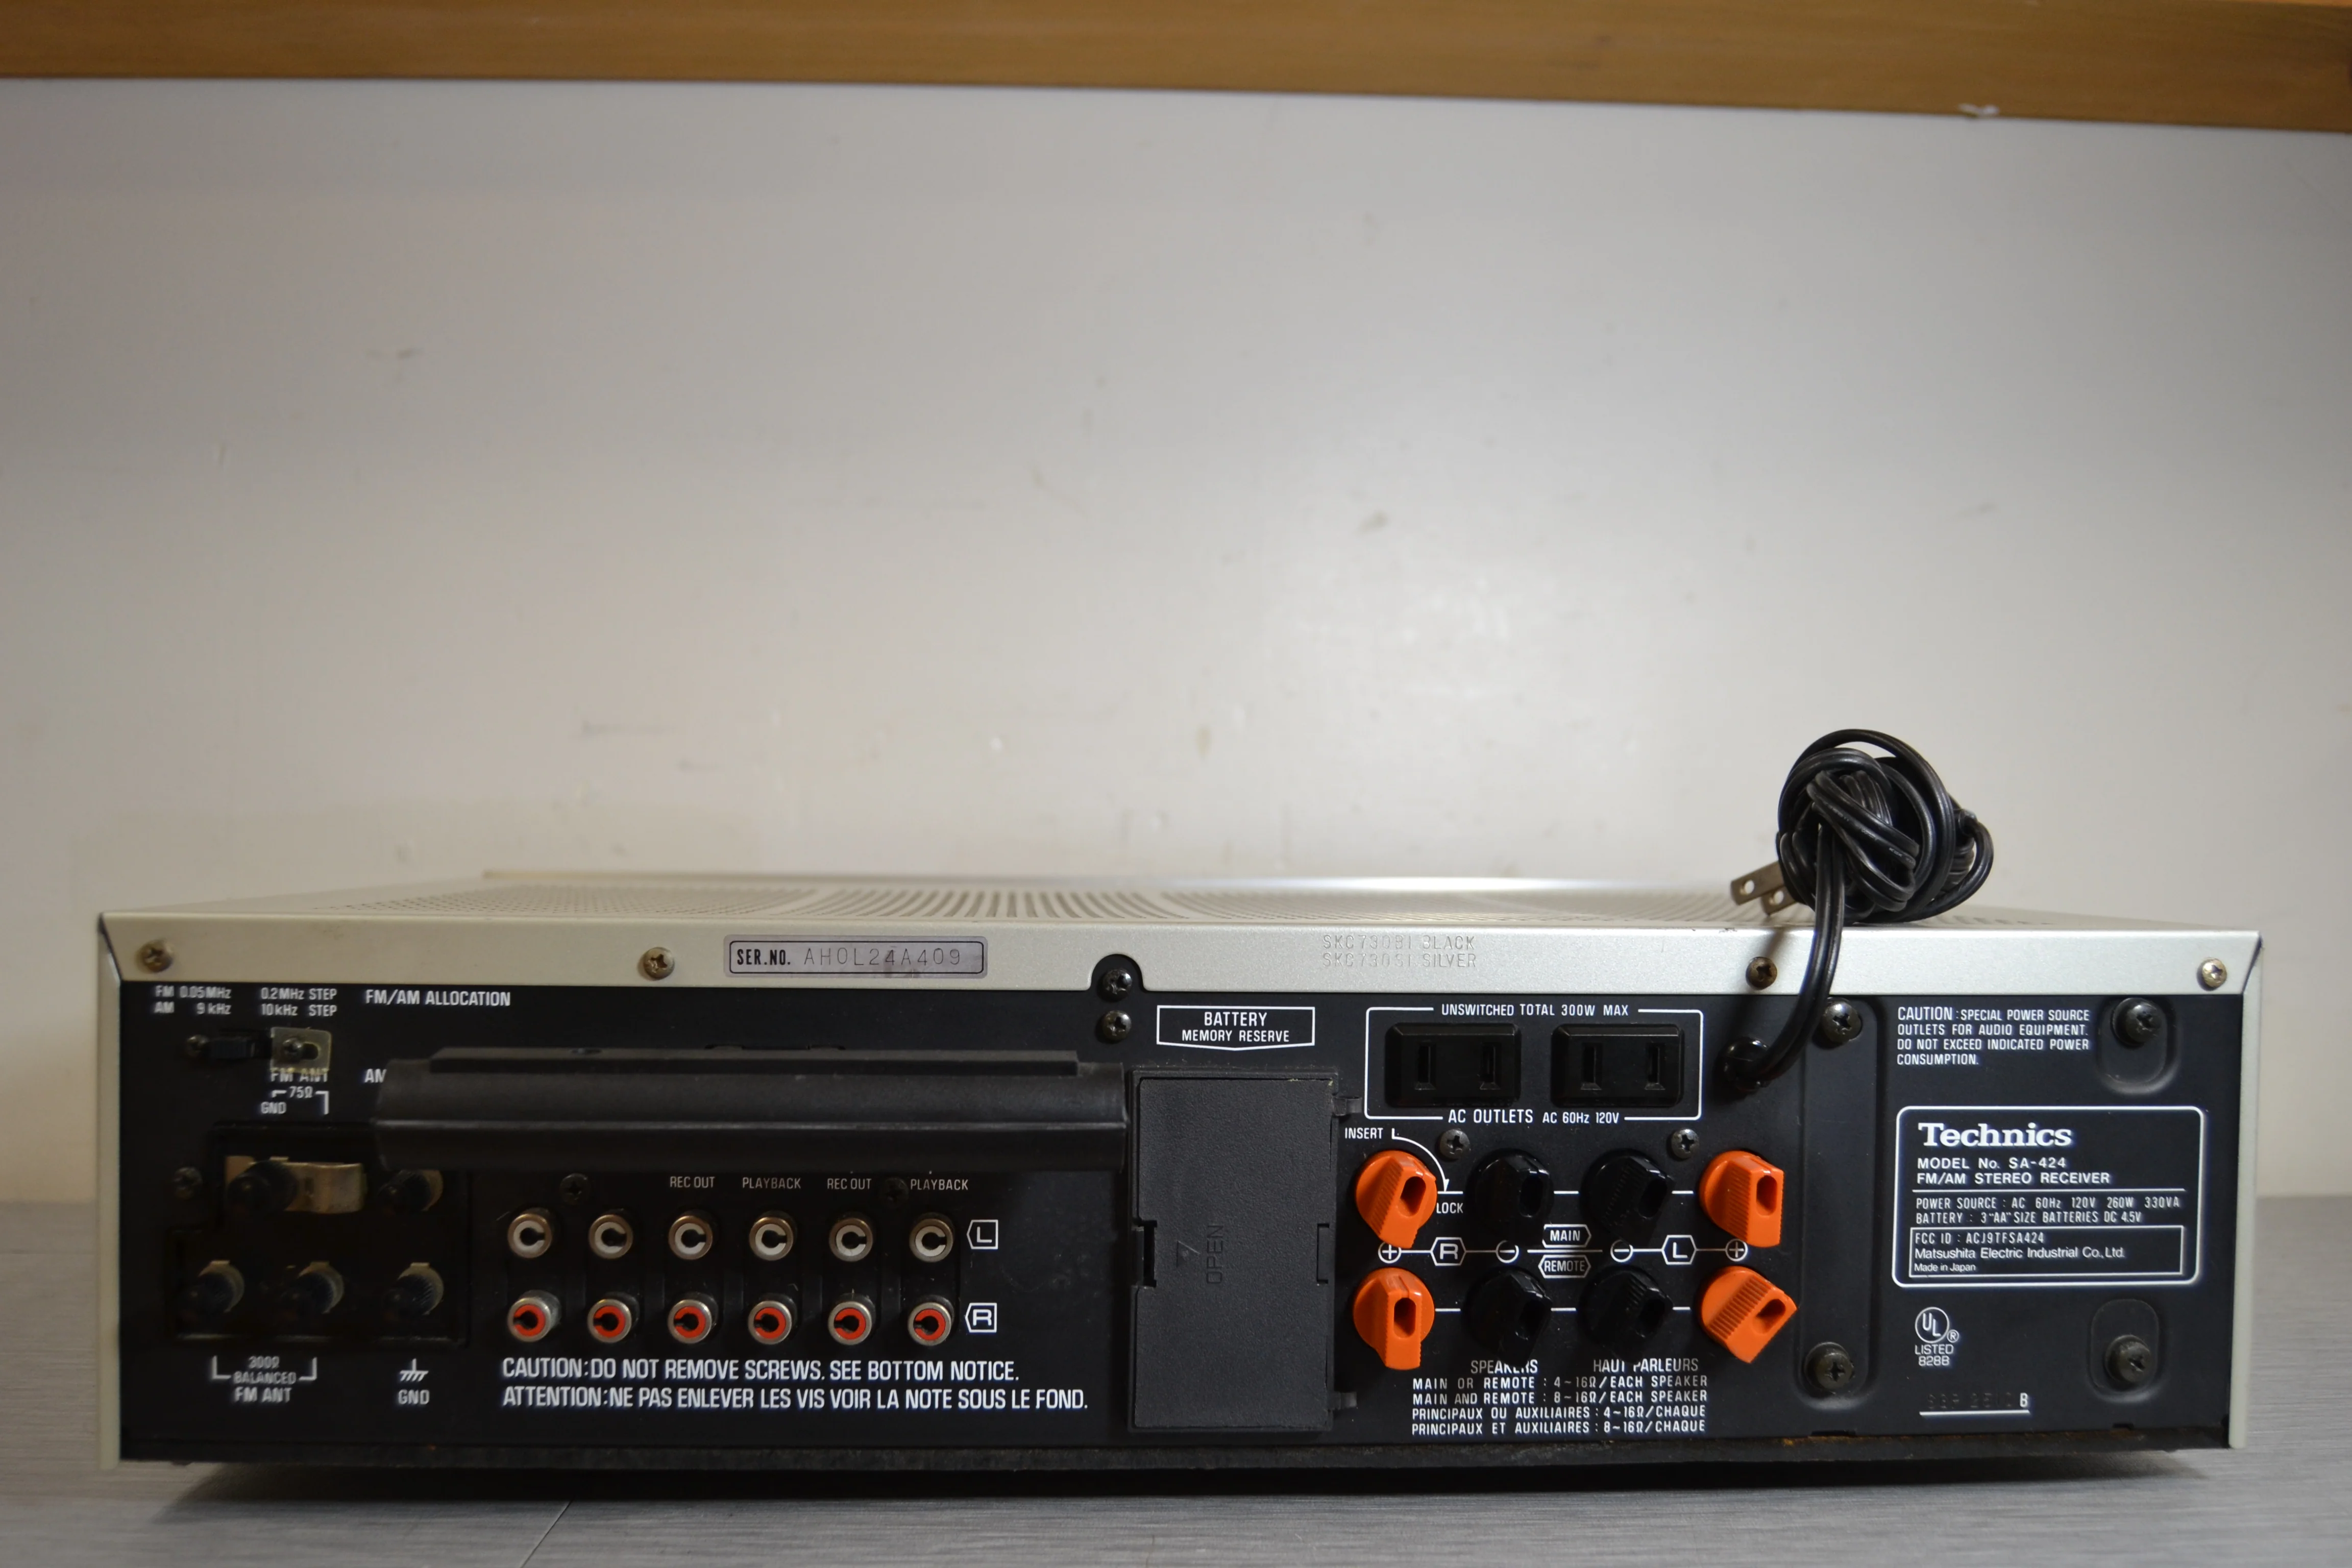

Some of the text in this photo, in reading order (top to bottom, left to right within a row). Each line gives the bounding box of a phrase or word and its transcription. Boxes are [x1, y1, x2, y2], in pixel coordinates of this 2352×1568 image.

[1423, 936, 1476, 950] BLACK
[1423, 953, 1478, 968] SILVER
[156, 985, 174, 997] FM
[309, 988, 337, 1000] STEP
[365, 989, 510, 1007] FM/AM ALLOCATION
[155, 1001, 174, 1013] AM
[309, 1004, 337, 1017] STEP
[1441, 1003, 1628, 1016] UNSWITCHED TOTAL 300W MAX
[1898, 1006, 1952, 1021] CAUTION
[1961, 1009, 2002, 1021] SPECIAL
[2007, 1009, 2044, 1021] POWER
[2048, 1009, 2089, 1021] SOURCE
[1204, 1011, 1267, 1026] BATTERY
[1182, 1030, 1289, 1042] MEMORY RESERVE
[1898, 1023, 2089, 1036] OUTLETS FOR AUDIO EQUIPMENT.
[1897, 1038, 2089, 1050] DO NOT EXCEED INDICATED POWER
[1897, 1054, 1979, 1065] CONSUMPTION.
[270, 1066, 329, 1082] FM ANT
[261, 1101, 286, 1114] GND
[1448, 1109, 1620, 1124] AC OUTLETS AC 60Hz 120V
[1344, 1127, 1384, 1139] INSERT
[1918, 1122, 2072, 1147] Technics
[1917, 1157, 2066, 1169] MODEL No. SA-424
[670, 1176, 715, 1188] REC OUT
[742, 1177, 801, 1189] PLAYBACK
[827, 1178, 872, 1190] REC OUT
[1917, 1171, 2110, 1185] FM/AM STEREO RECEIVER
[911, 1179, 968, 1191] PLAYBACK
[1436, 1202, 1463, 1214] LOCK
[1916, 1197, 1951, 1210] POWER
[1956, 1197, 1997, 1209] SOURCE
[2011, 1197, 2025, 1209] AC
[2035, 1197, 2062, 1209] 60Hz
[2071, 1196, 2096, 1209] 120V
[2107, 1196, 2134, 1209] 260W
[2144, 1196, 2180, 1209] 330VA
[1916, 1212, 1963, 1224] BATTERY
[2042, 1211, 2099, 1223] BATTERIES
[2104, 1211, 2117, 1223] DC
[2121, 1211, 2142, 1223] 4.5V
[976, 1226, 993, 1243] L
[1550, 1230, 1580, 1241] MAIN
[1915, 1232, 1935, 1244] FCC
[1941, 1232, 1952, 1244] ID
[1206, 1224, 1224, 1285] OPEN
[1439, 1243, 1458, 1260] R
[1672, 1242, 1688, 1259] L
[1915, 1247, 1976, 1259] Matsushita
[1980, 1247, 2023, 1259] Electric
[2027, 1246, 2078, 1259] Industrial
[1544, 1260, 1585, 1272] REMOTE
[1914, 1263, 1939, 1272] Made
[1949, 1263, 1976, 1273] Japan
[972, 1310, 992, 1326] R
[1915, 1343, 1954, 1355] LISTED
[622, 1358, 659, 1379] NOT
[665, 1359, 739, 1380] REMOVE
[745, 1359, 825, 1380] SCREWS.
[830, 1360, 862, 1380] SEE
[868, 1360, 943, 1381] BOTTOM
[950, 1360, 1019, 1381] NOTICE.
[233, 1371, 297, 1385] BALANCED
[1413, 1378, 1447, 1390] MAIN
[1458, 1377, 1474, 1389] OR
[1483, 1376, 1535, 1389] REMOTE
[1651, 1375, 1707, 1388] SPEAKER
[234, 1386, 291, 1403] FM ANT
[398, 1389, 429, 1405] GND
[639, 1387, 672, 1408] PAS
[677, 1388, 754, 1408] ENLEVER
[761, 1388, 791, 1409] LES
[796, 1388, 825, 1409] VIS
[830, 1388, 871, 1409] VOIR
[877, 1389, 899, 1409] LA
[905, 1388, 952, 1409] NOTE
[958, 1388, 1006, 1409] SOUS
[1012, 1389, 1030, 1409] LE
[1036, 1388, 1088, 1409] FOND.
[1413, 1393, 1447, 1405] MAIN
[1454, 1392, 1478, 1405] AND
[1483, 1391, 1535, 1405] REMOTE
[1651, 1389, 1707, 1403] SPEAKER
[1412, 1407, 1483, 1420] PRINCIPAUX
[1491, 1407, 1507, 1419] OU
[1515, 1406, 1590, 1419] AUXILIAIRES
[1412, 1423, 1483, 1435] PRINCIPAUX
[1492, 1422, 1506, 1434] ET
[1514, 1421, 1589, 1434] AUXILIAIRES
